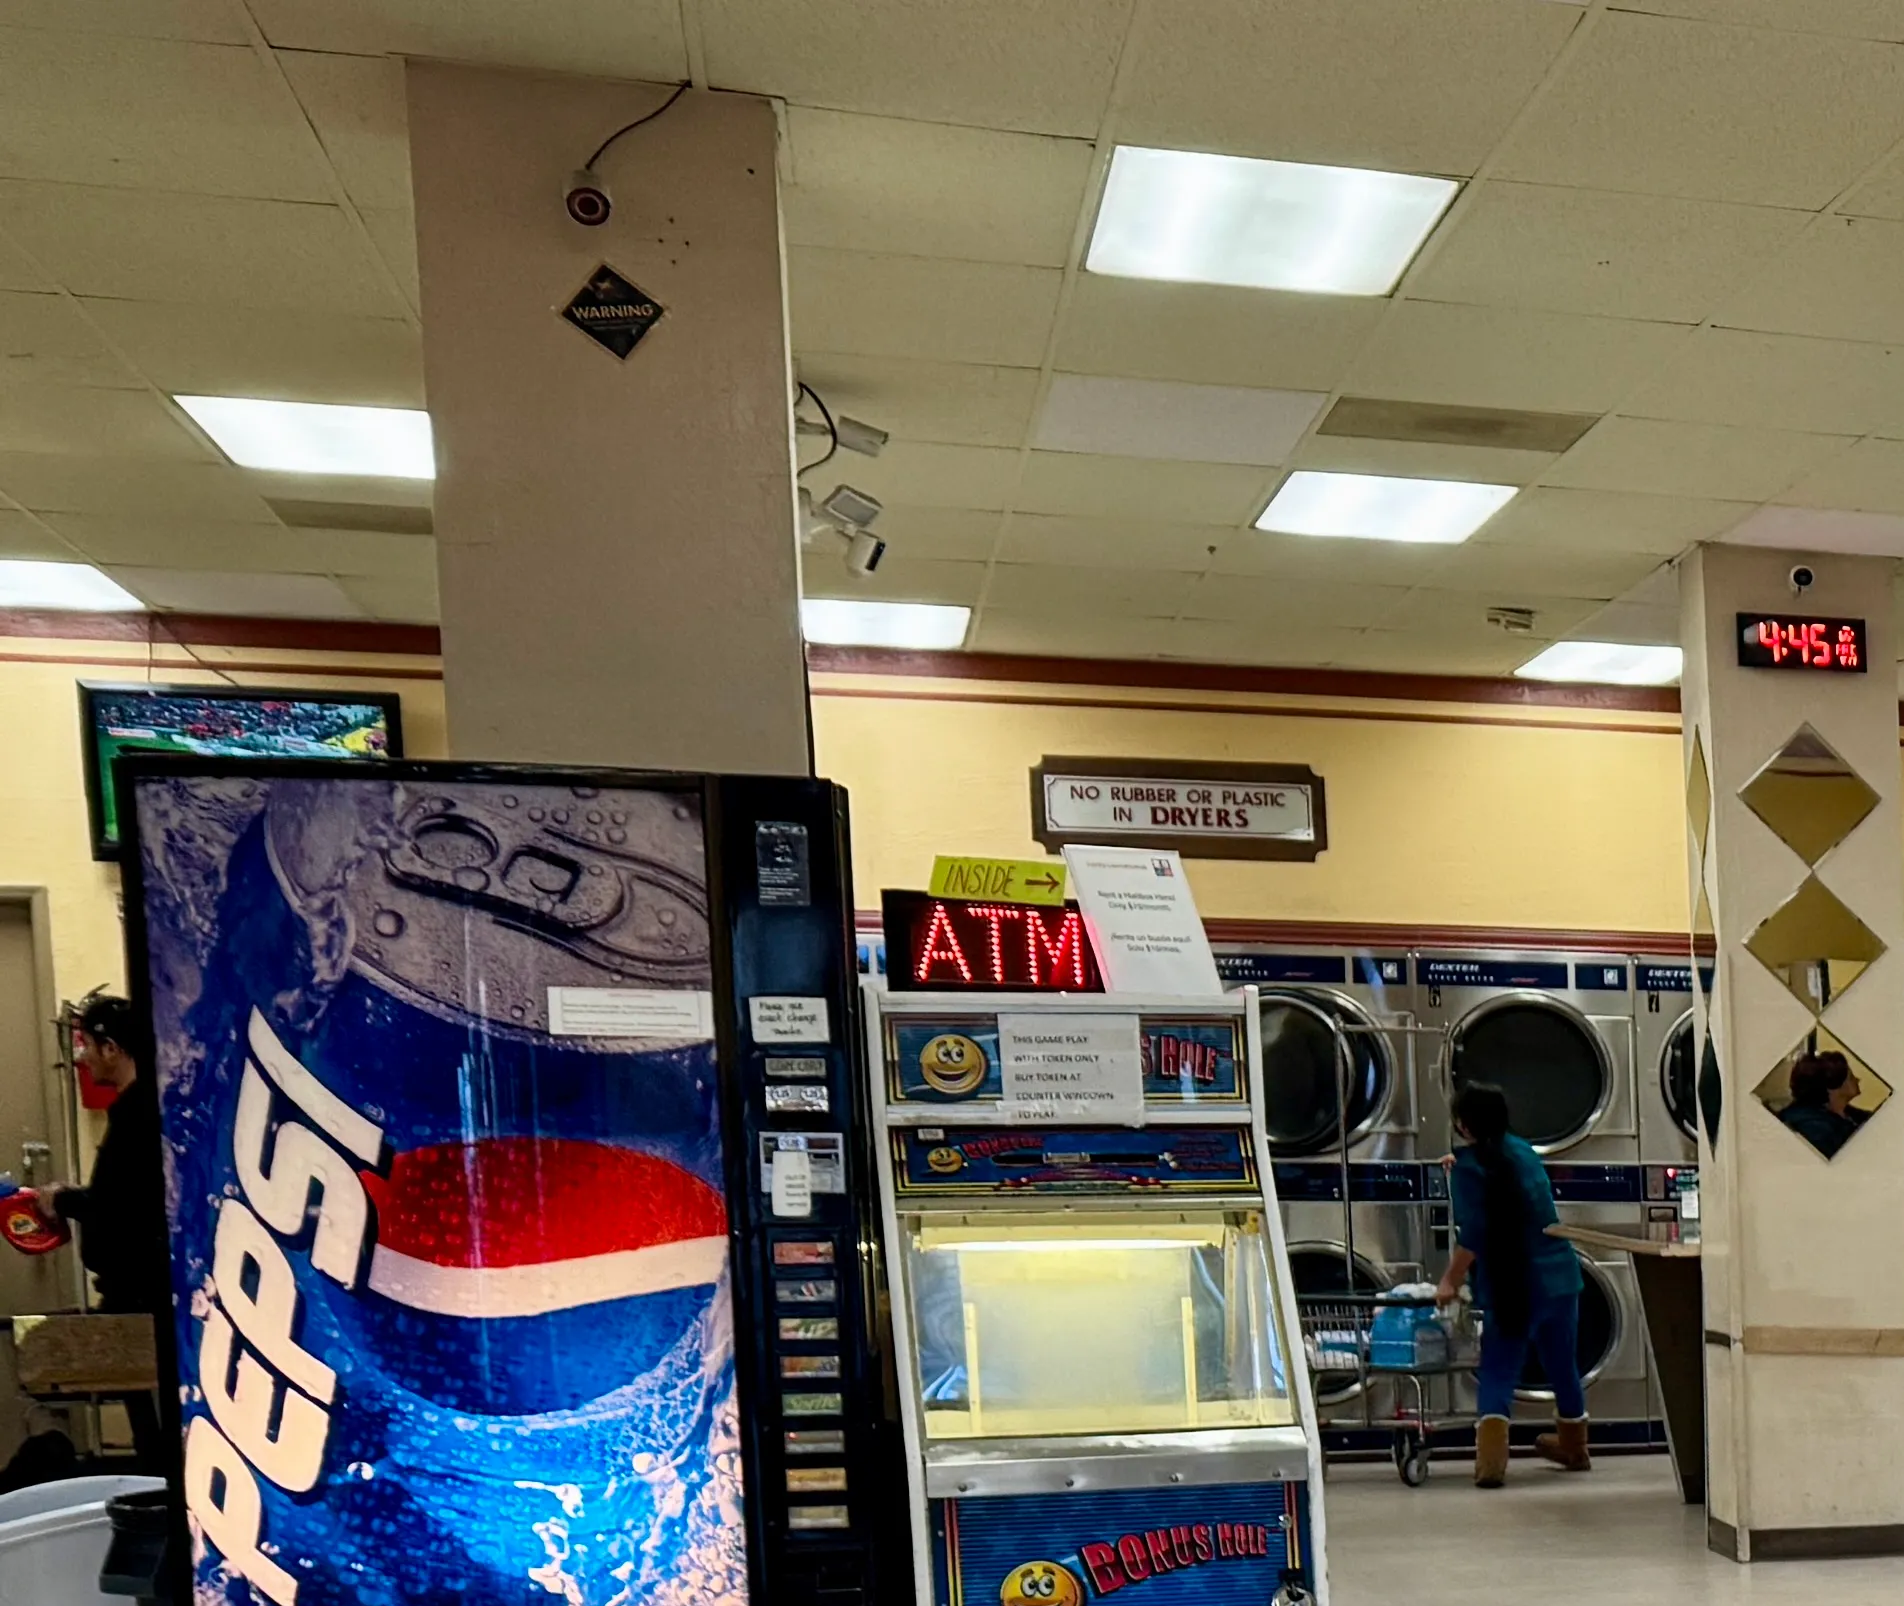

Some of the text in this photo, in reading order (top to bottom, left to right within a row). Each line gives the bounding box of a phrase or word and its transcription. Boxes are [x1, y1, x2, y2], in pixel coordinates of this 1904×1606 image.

[571, 304, 654, 319] WARNING
[1758, 620, 1831, 666] 4:45
[1070, 784, 1286, 807] NO RUBBER OR PLASTIC
[1113, 806, 1249, 829] IN DRYERS
[943, 863, 1016, 897] INSIDE
[914, 901, 1084, 986] ATM
[1012, 1035, 1089, 1045] THIS GAME PLAY
[1042, 1055, 1073, 1064] TOKEN
[1074, 1055, 1100, 1064] ONLY
[1015, 1073, 1081, 1082] BUY TOKEN AT
[1016, 1092, 1061, 1101] COUNTER
[1081, 1522, 1269, 1597] BONUS HOLE
